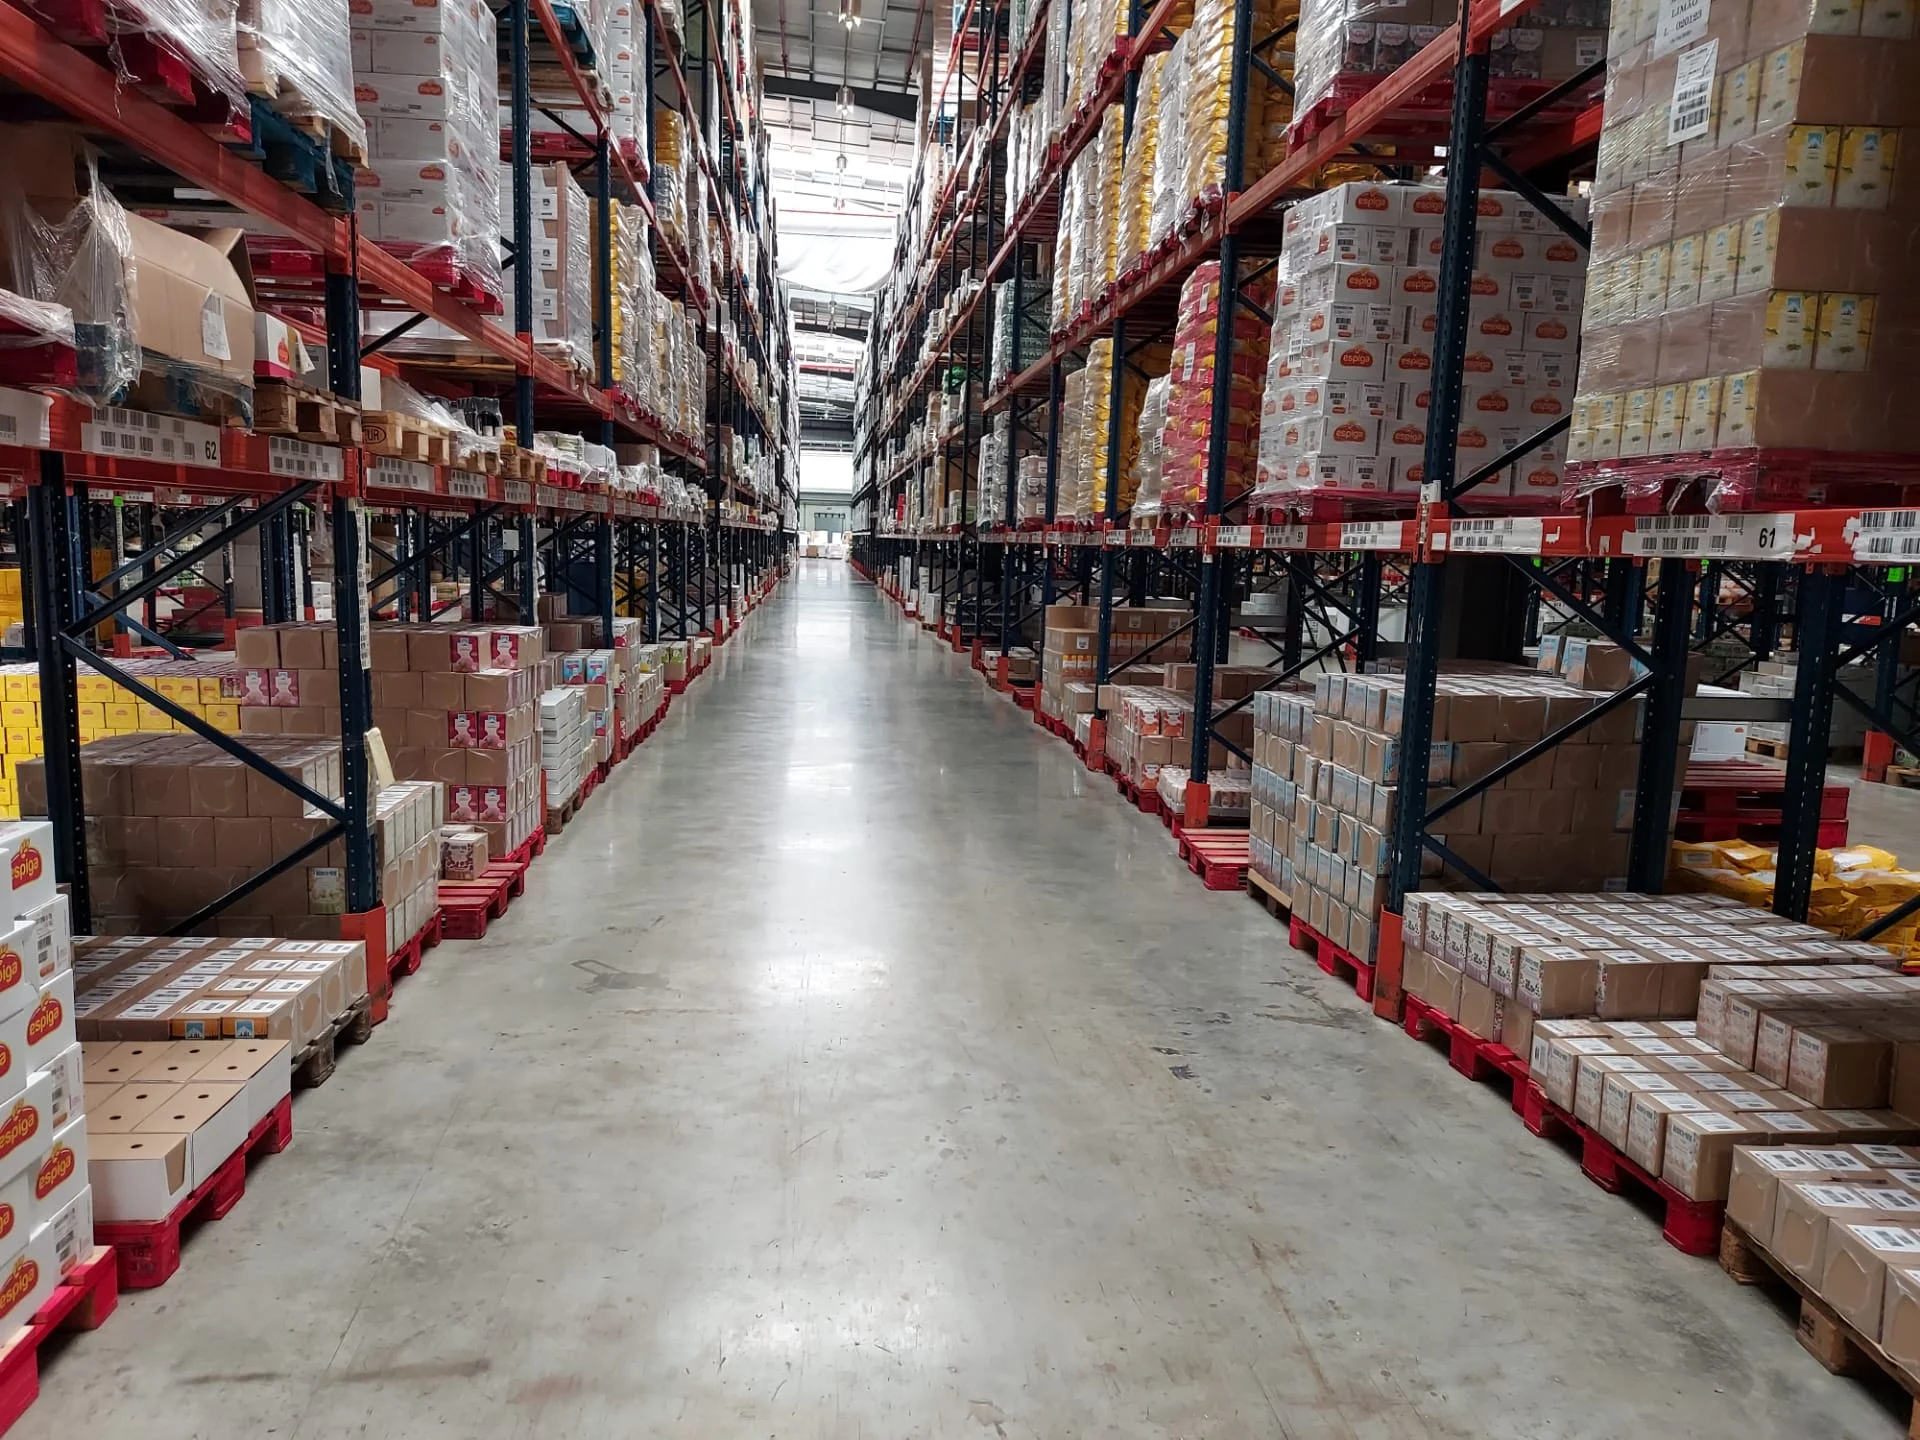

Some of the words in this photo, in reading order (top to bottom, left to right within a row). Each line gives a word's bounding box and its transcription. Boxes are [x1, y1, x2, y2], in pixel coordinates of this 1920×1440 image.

[205, 440, 217, 460] 62
[1759, 527, 1776, 548] 61
[12, 857, 39, 881] spiga
[29, 1006, 59, 1036] espiga
[39, 1155, 70, 1190] espiga
